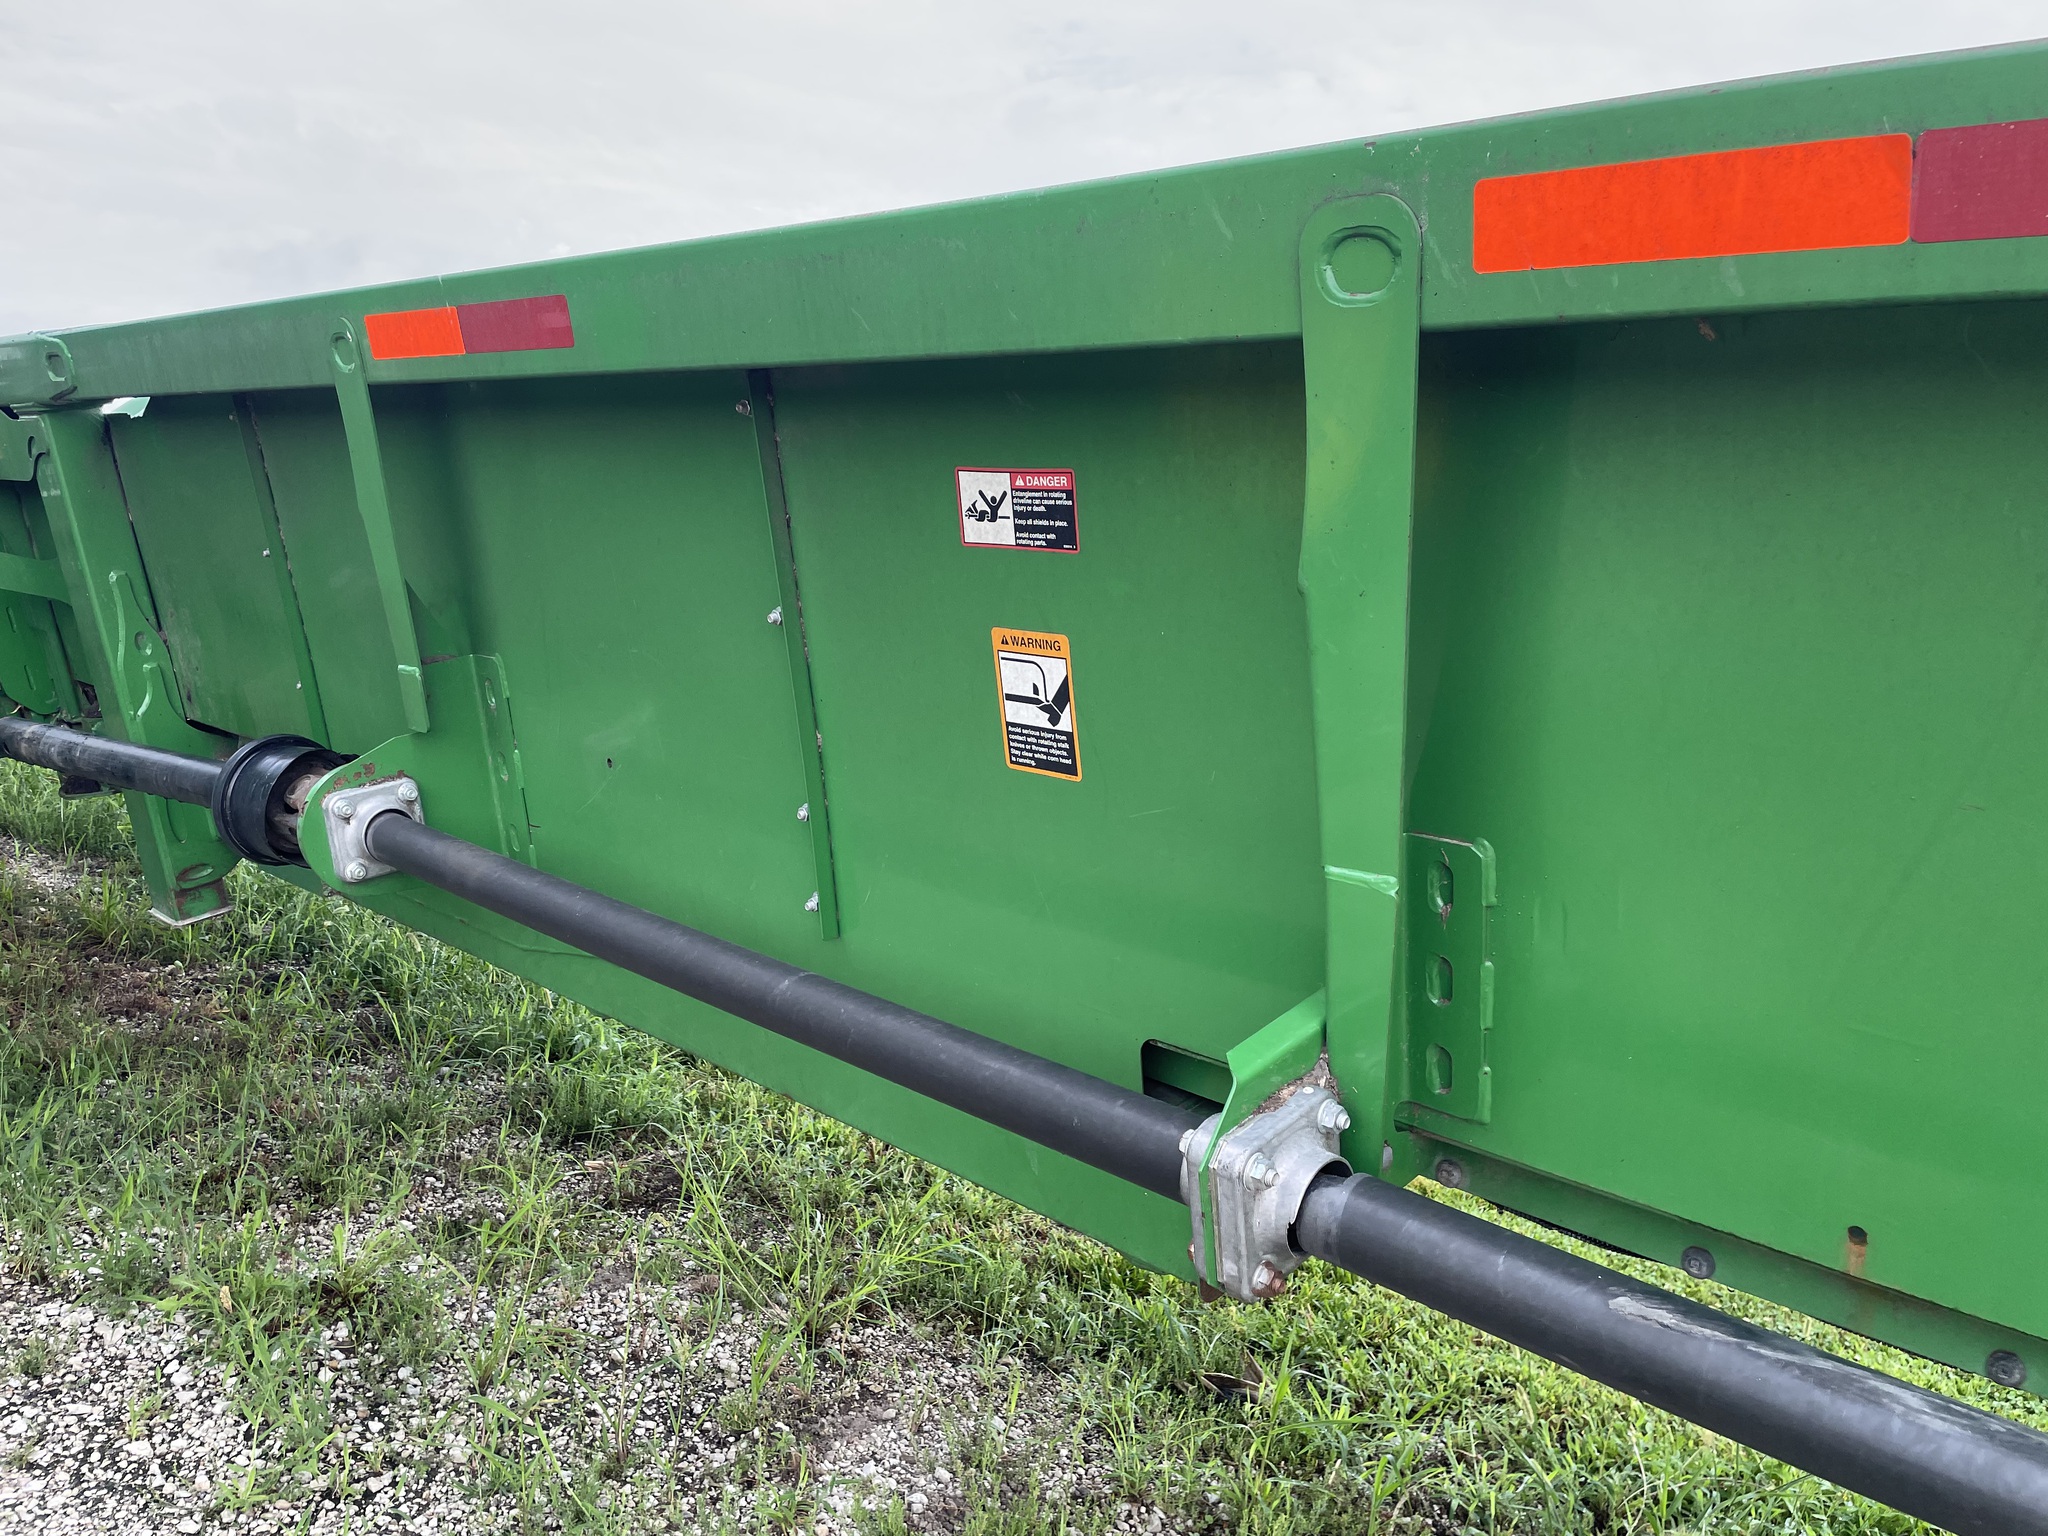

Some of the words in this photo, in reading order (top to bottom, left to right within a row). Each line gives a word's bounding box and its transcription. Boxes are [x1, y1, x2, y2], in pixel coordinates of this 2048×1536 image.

[1026, 476, 1067, 486] DANGER
[1010, 636, 1061, 651] WARNING
[1040, 731, 1054, 740] injury
[1038, 739, 1056, 748] rotating
[1010, 748, 1020, 756] Stay
